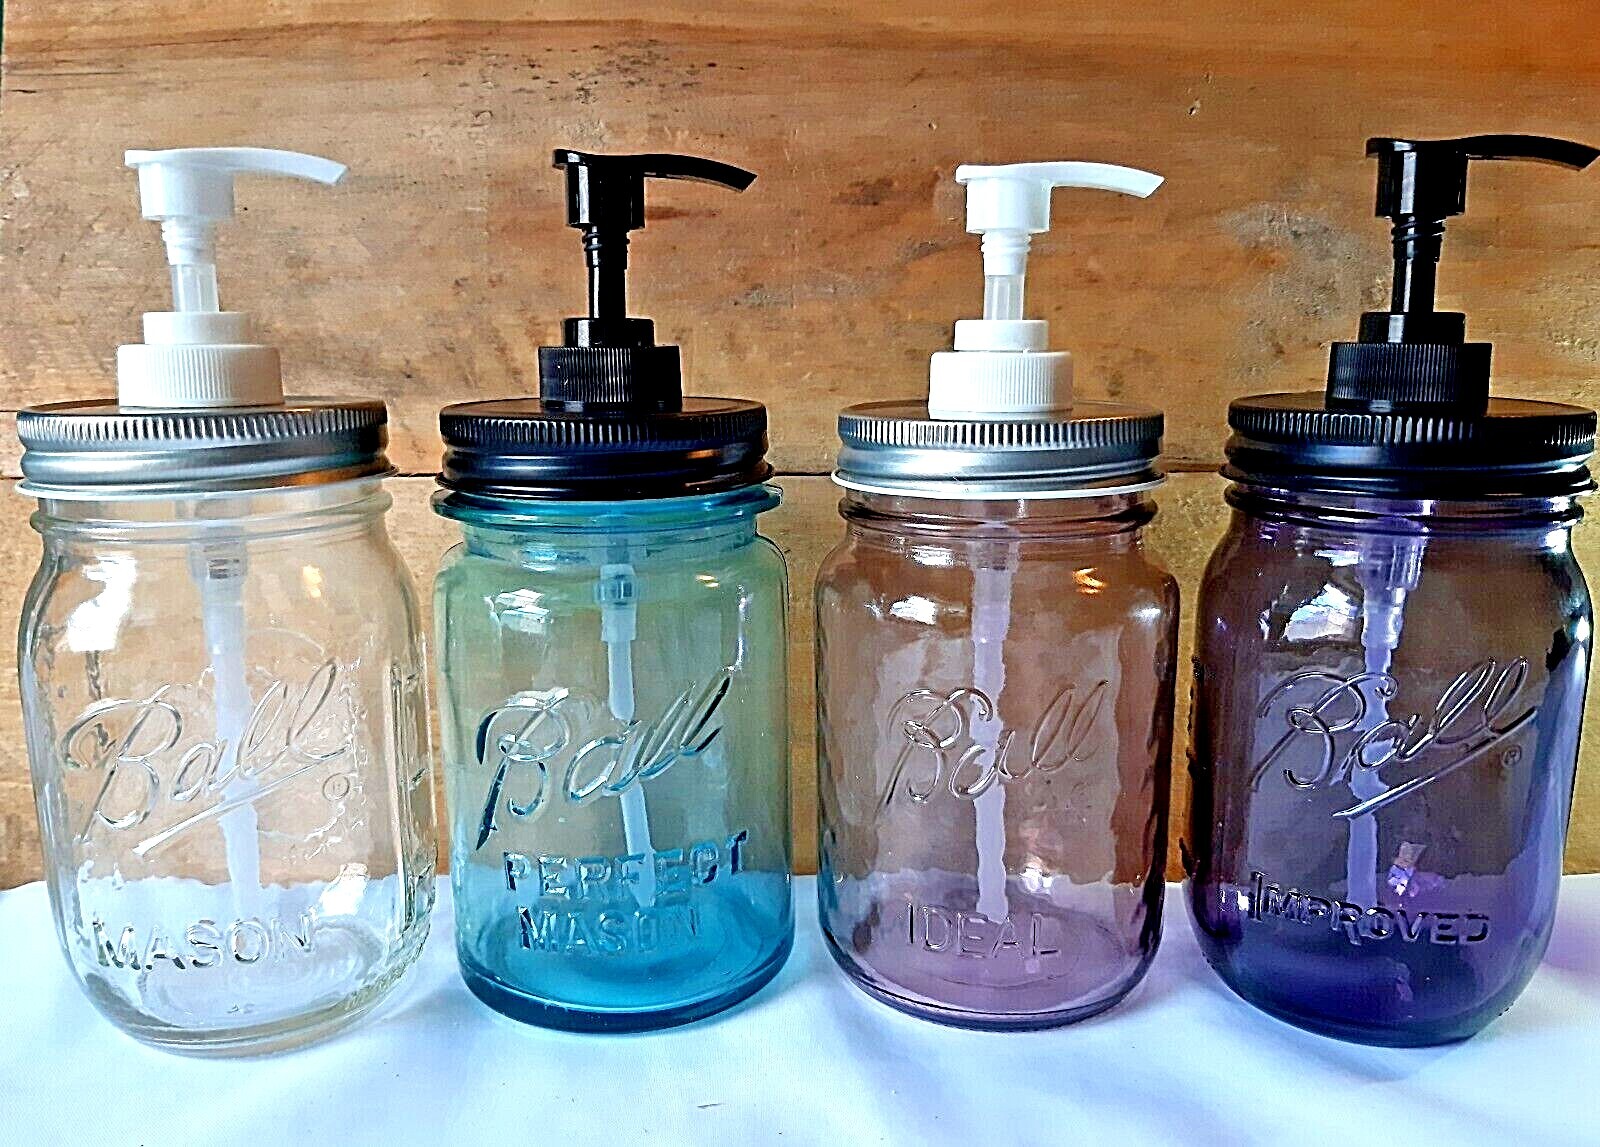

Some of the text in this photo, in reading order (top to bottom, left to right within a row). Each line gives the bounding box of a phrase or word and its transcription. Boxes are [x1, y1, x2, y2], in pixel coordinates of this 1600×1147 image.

[62, 657, 352, 855] Ball
[476, 669, 732, 850] Ball
[873, 680, 1107, 818] Ball
[1252, 656, 1537, 818] Ball
[504, 830, 748, 899] PERFECT
[1249, 871, 1491, 947] IMPROVED
[91, 906, 318, 971] MASON
[904, 902, 1062, 959] IDEAL
